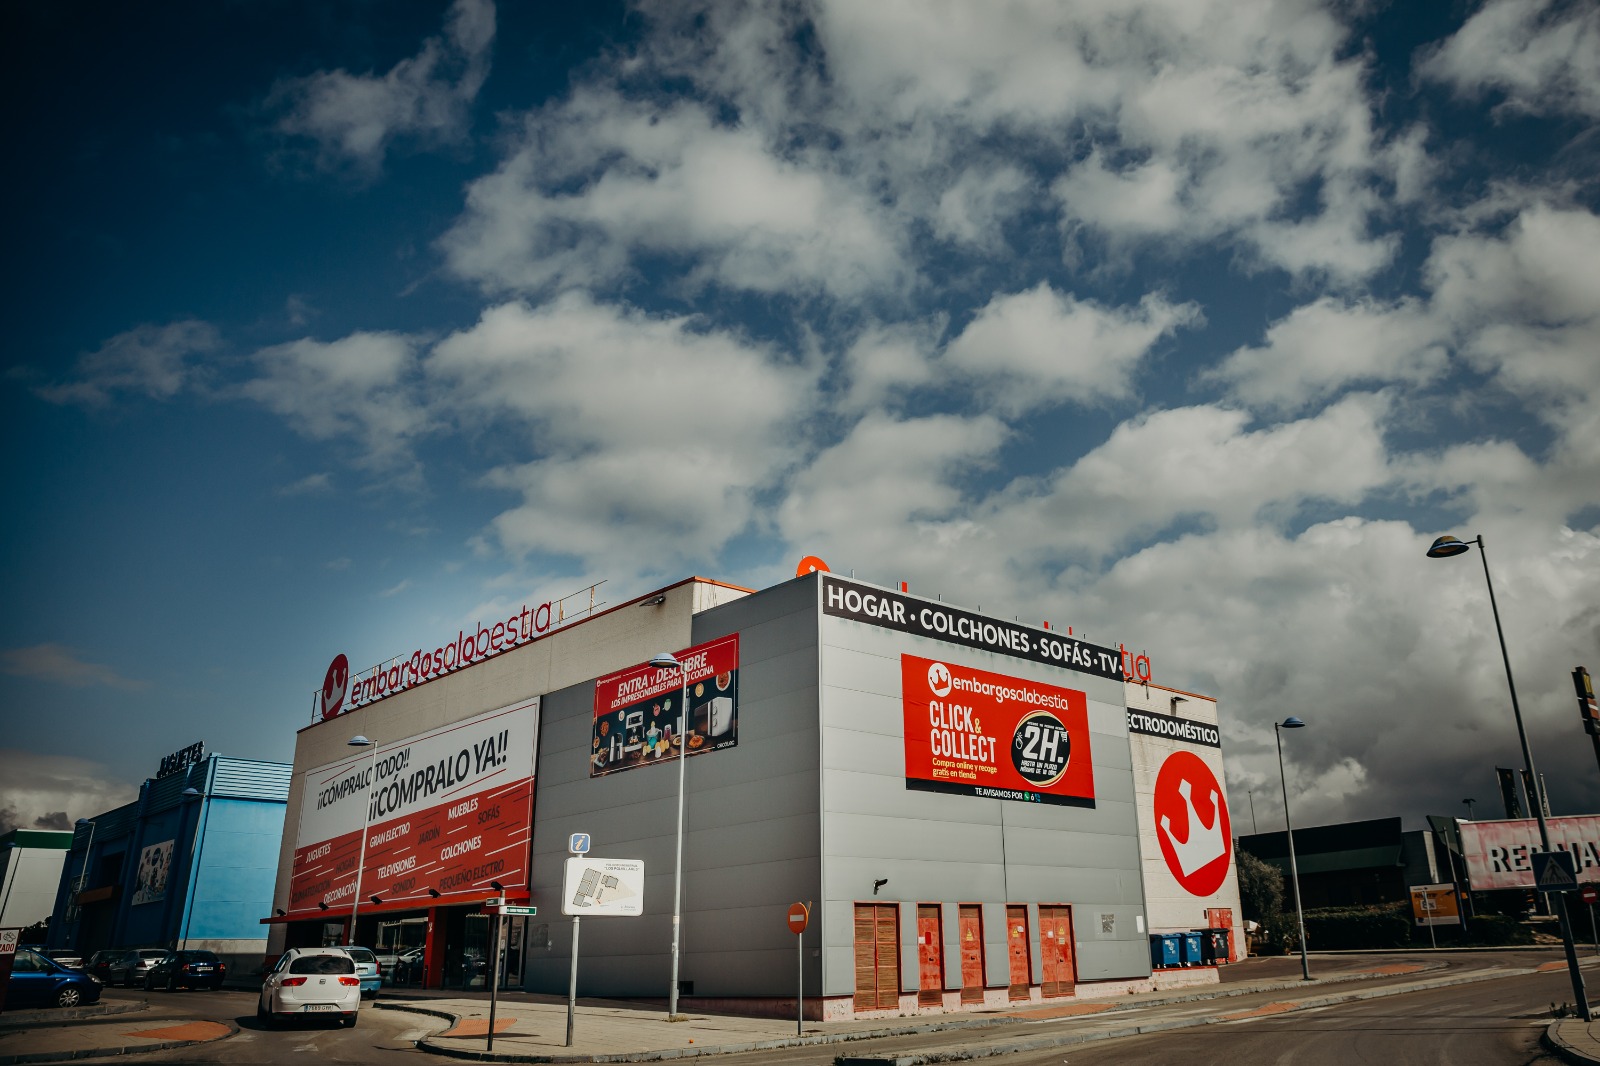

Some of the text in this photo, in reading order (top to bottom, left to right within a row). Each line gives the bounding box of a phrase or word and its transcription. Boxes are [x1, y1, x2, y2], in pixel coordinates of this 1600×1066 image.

[828, 584, 907, 625] HOGAR
[920, 608, 1030, 653] COLCHONES
[1040, 641, 1092, 668] SOFÁS
[351, 601, 551, 704] embargosalobestia
[611, 697, 621, 709] LOS
[621, 681, 667, 705] IMPRESCINDIBLES
[666, 676, 682, 690] PARA
[690, 665, 714, 681] COCINA
[617, 674, 649, 697] ENTRA
[952, 677, 1069, 711] embargosalobestia
[929, 700, 982, 734] CLICK &
[474, 729, 509, 775] YA!!
[930, 728, 996, 763] COLLECT
[932, 757, 998, 775] Compra online y recoge
[932, 768, 949, 777] gratis
[958, 769, 977, 780] tienda
[974, 787, 983, 796] TE
[982, 788, 1012, 799] AVISAMOS
[1011, 791, 1024, 800] POR
[448, 797, 479, 821] MUEBLES
[477, 804, 500, 825] SOFÁS
[370, 822, 411, 848] GRAN ELECTRO
[418, 825, 441, 846] JARDÍN
[305, 843, 331, 864] JUGUETES
[440, 835, 482, 861] COLCHONES
[336, 856, 356, 874] HOGAR
[377, 855, 416, 880] TELEVISIONES
[439, 859, 505, 890] PEQUEÑO ELECTRO
[323, 879, 358, 904] DECORACIÓN
[392, 877, 416, 895] SONIDO
